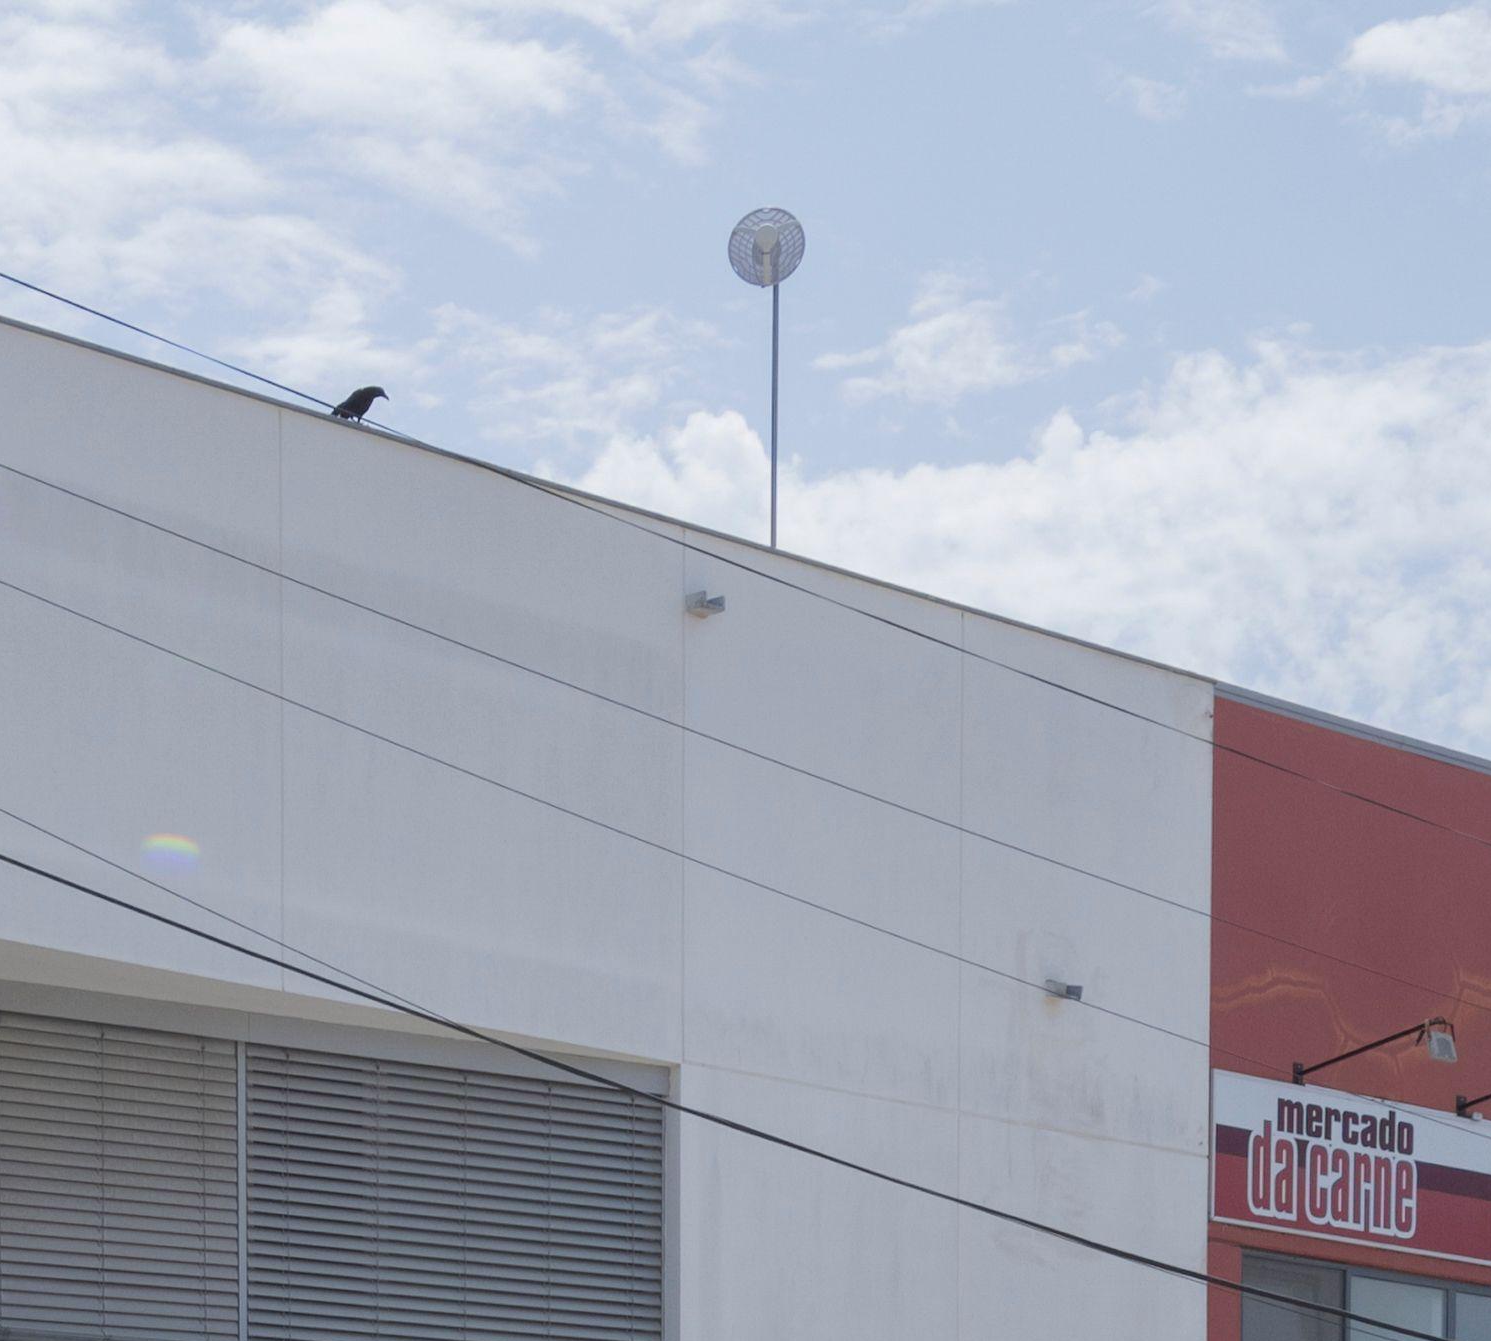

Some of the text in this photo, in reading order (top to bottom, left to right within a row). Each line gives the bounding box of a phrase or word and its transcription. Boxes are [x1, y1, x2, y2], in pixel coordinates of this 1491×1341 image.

[1277, 1097, 1414, 1156] mercado
[1251, 1119, 1414, 1234] da carne
